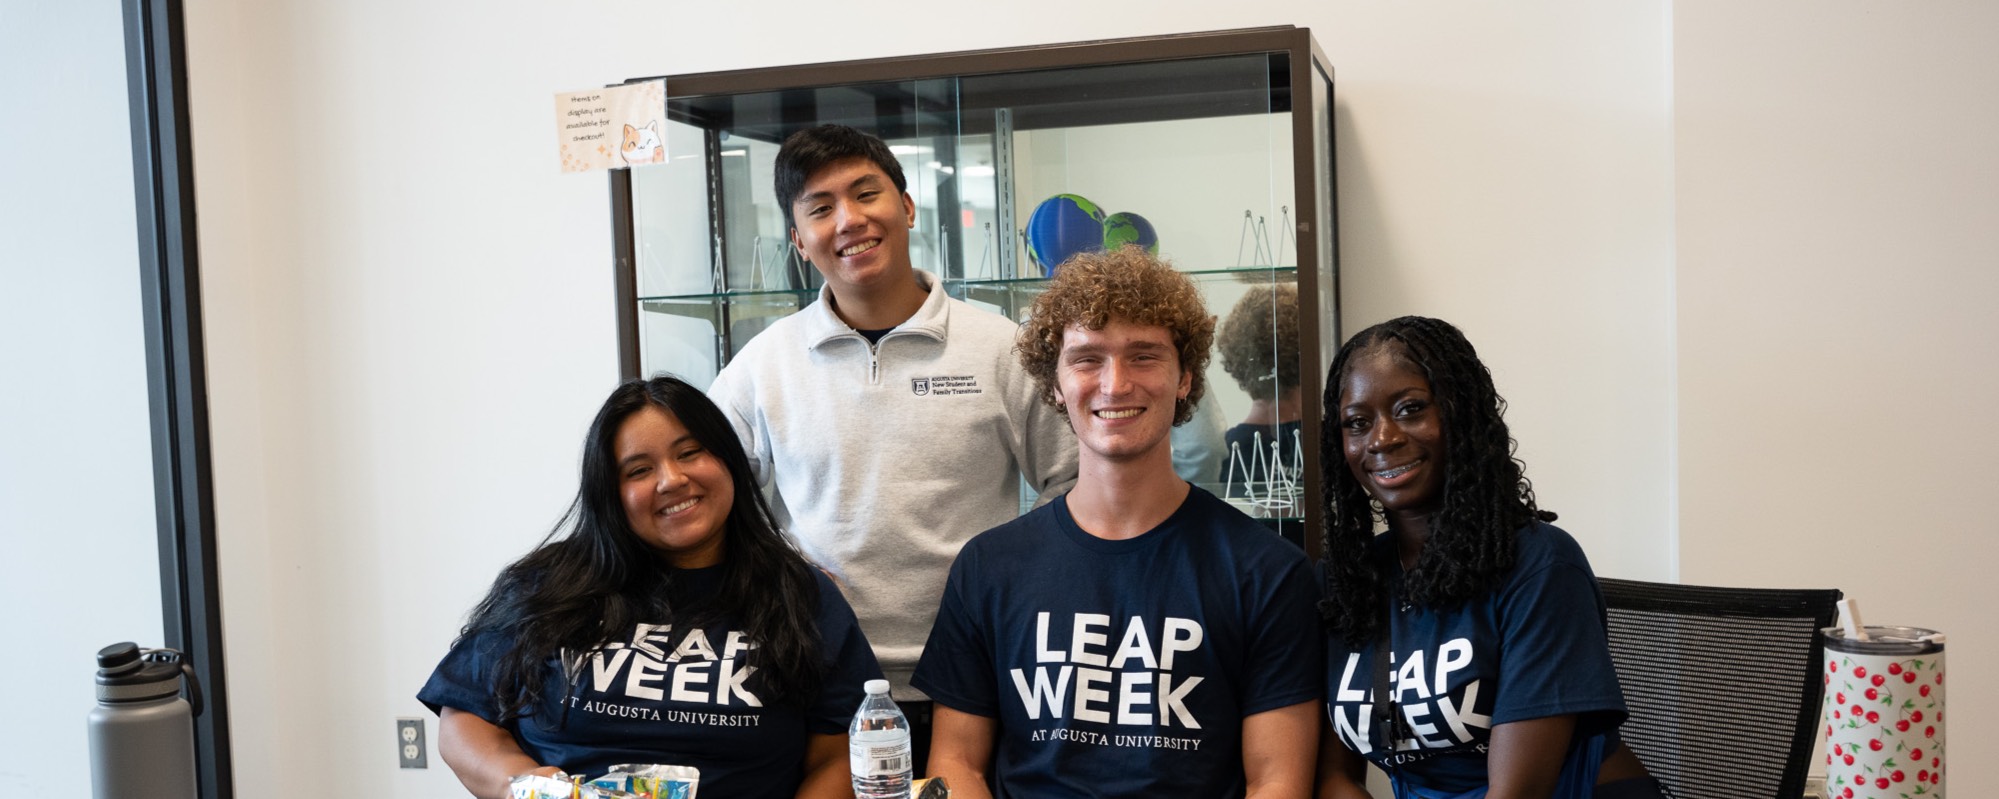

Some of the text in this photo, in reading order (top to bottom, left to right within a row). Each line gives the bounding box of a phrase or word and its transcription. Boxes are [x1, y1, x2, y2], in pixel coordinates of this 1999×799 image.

[566, 119, 610, 130] available for
[568, 109, 593, 118] display
[1036, 612, 1204, 670] LEAP
[1010, 665, 1205, 729] WEEK
[583, 700, 661, 721] AUGUSTA
[667, 710, 760, 727] UNIVERSITY
[1031, 728, 1201, 751] AT AUGUSTA UNIVERSITY
